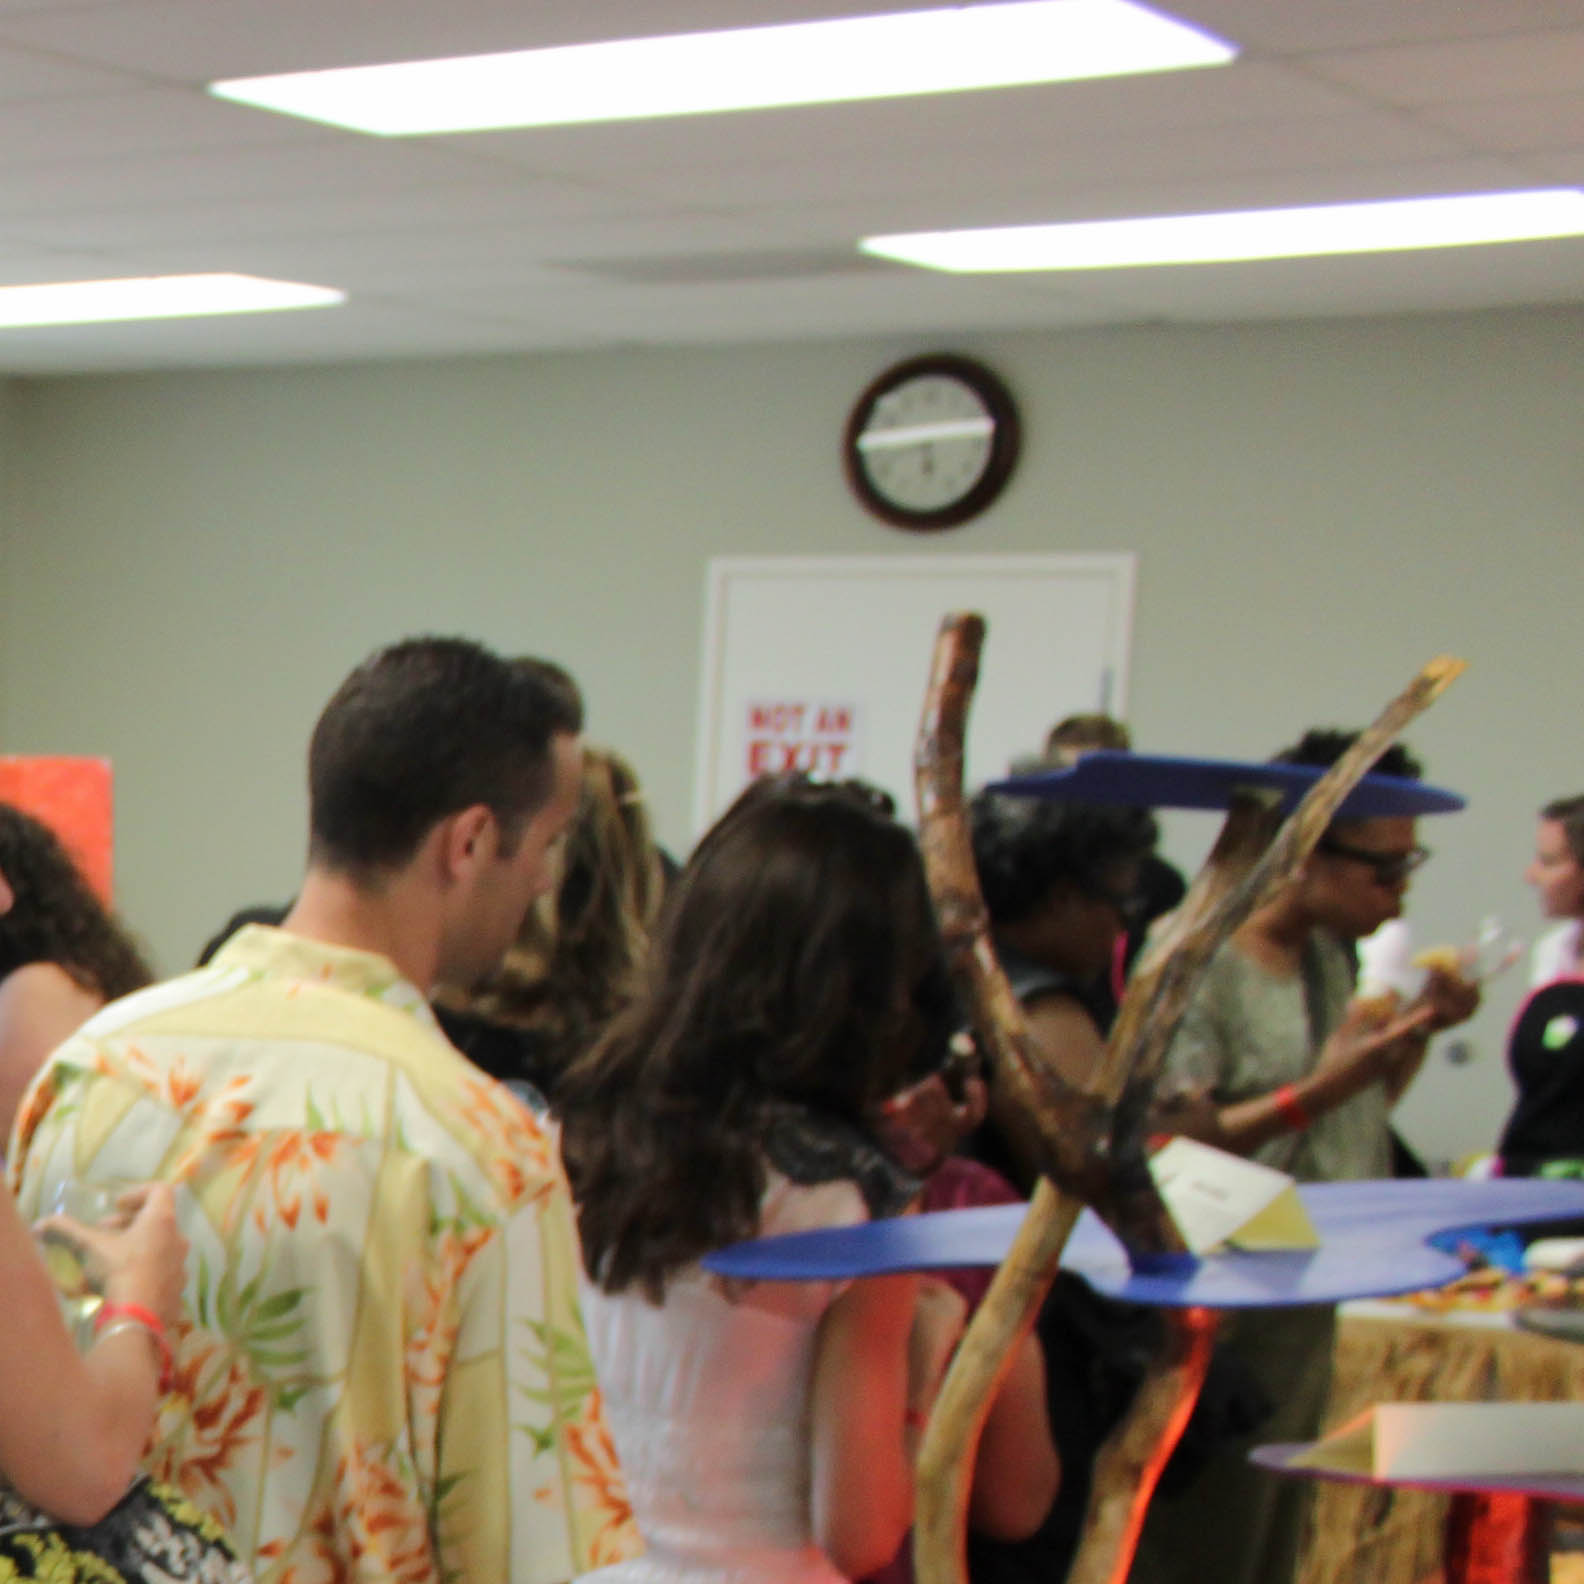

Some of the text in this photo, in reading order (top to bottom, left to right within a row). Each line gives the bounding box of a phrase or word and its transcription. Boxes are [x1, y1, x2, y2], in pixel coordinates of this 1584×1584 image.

[748, 704, 852, 733] NOT AN
[748, 741, 848, 777] EXIT
